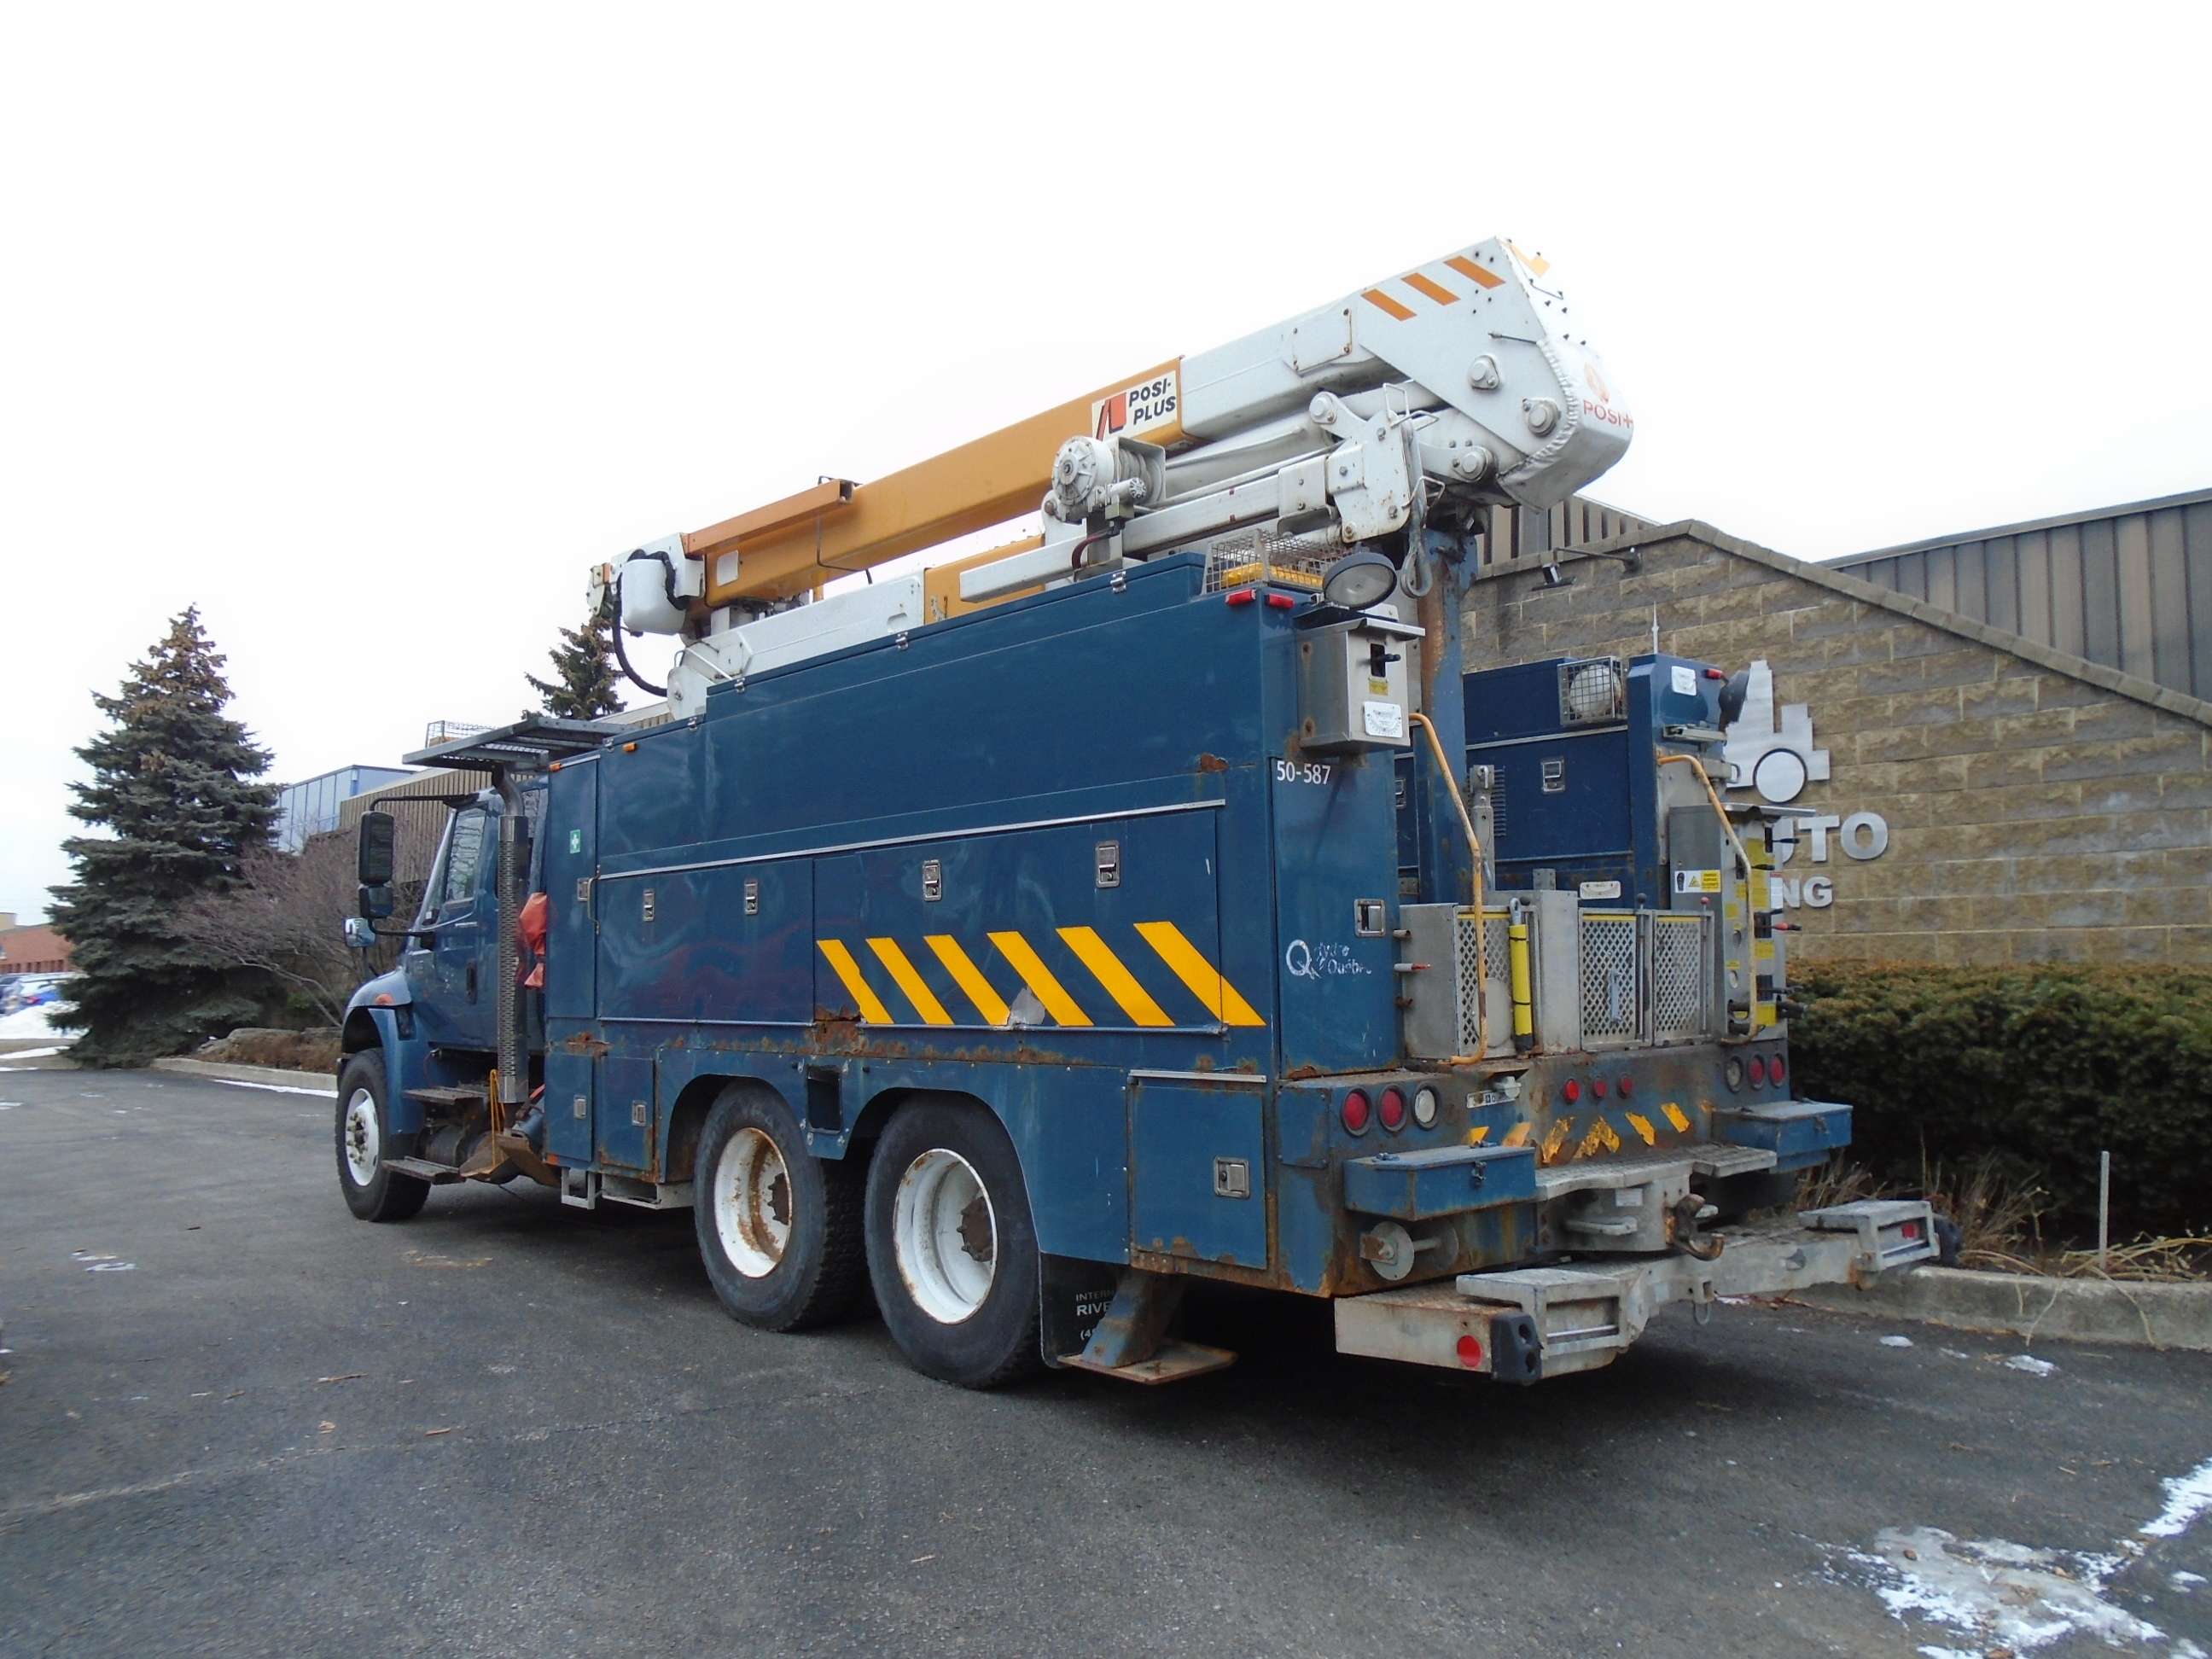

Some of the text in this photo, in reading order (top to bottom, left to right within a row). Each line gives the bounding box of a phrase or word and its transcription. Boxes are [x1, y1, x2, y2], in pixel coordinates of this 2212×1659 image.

[1133, 396, 1177, 425] PLUS
[1277, 760, 1331, 784] 50-587
[1782, 812, 1889, 863] TO
